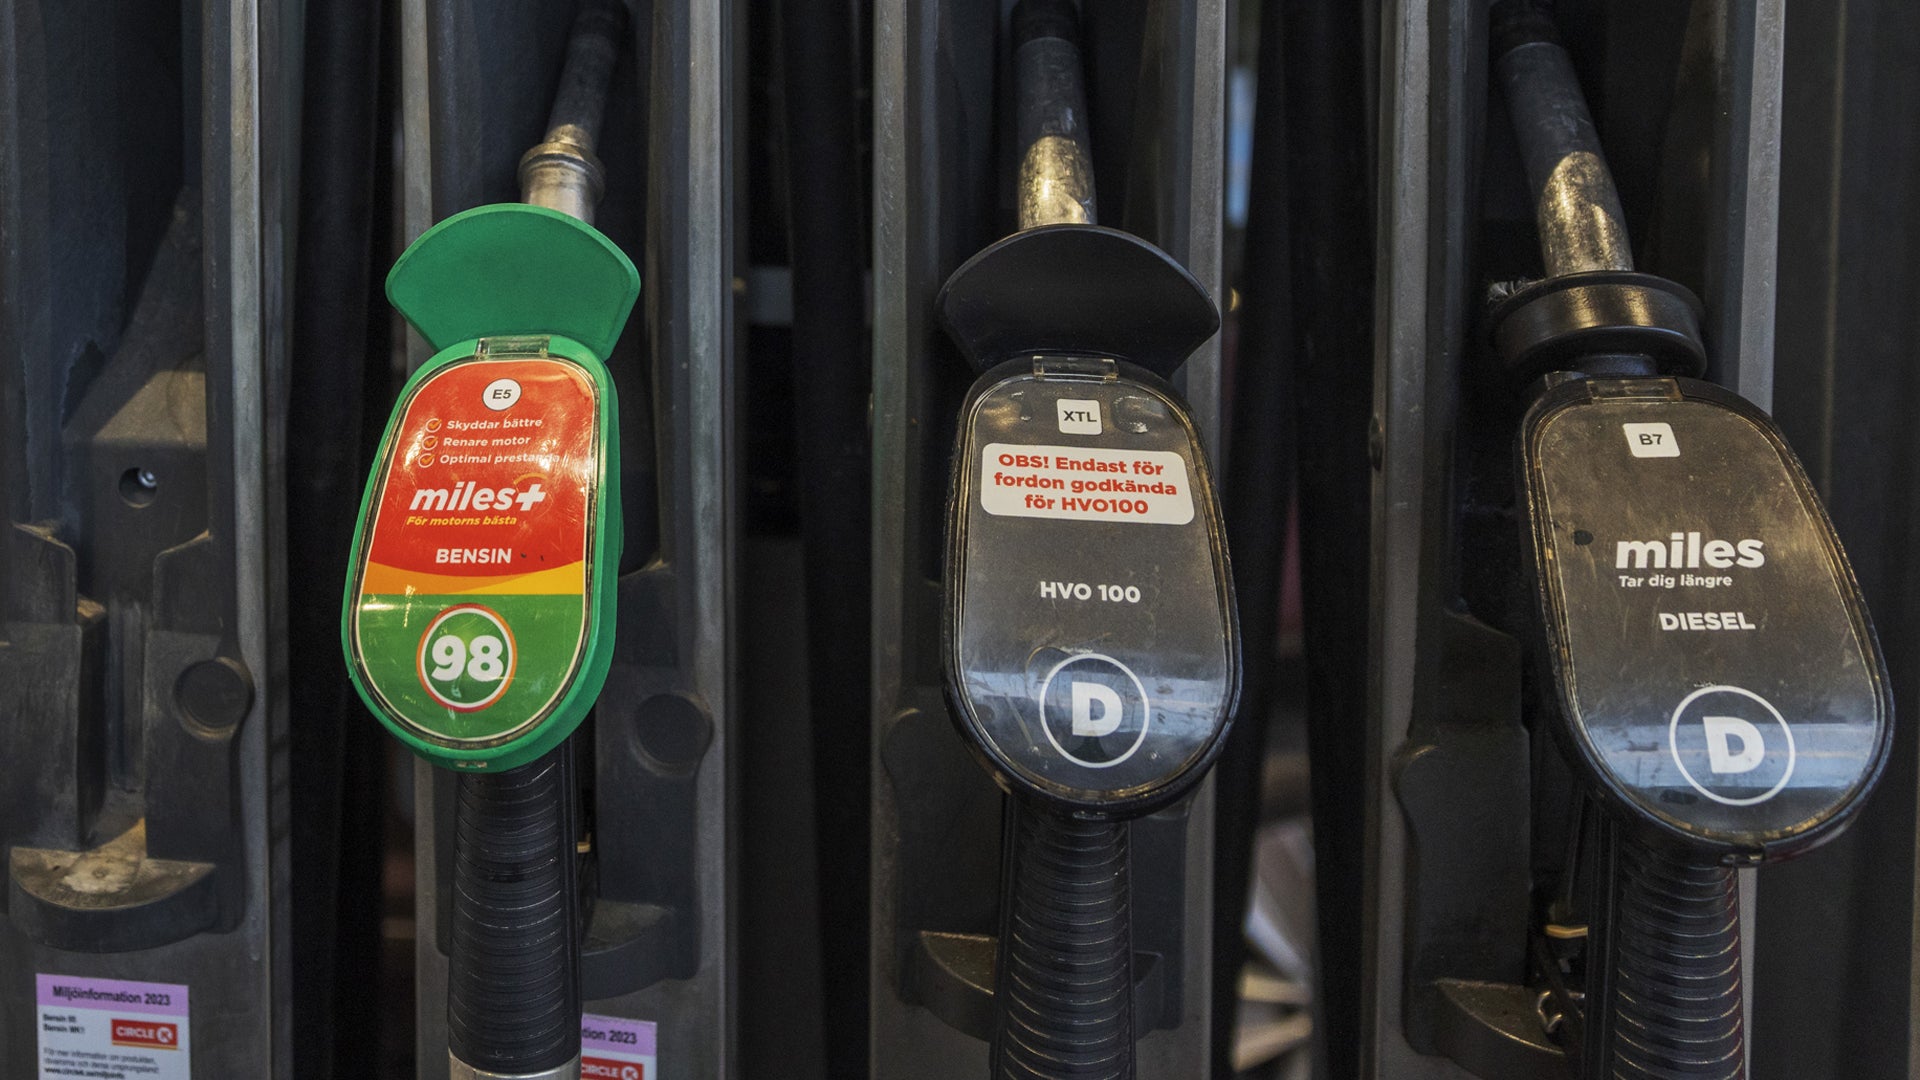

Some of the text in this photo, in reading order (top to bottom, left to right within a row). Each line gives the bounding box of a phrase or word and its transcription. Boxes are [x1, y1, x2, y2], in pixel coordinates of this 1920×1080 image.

[492, 389, 511, 400] E5
[446, 418, 543, 431] Skyddar bättre
[1063, 410, 1097, 423] XTL
[443, 436, 531, 447] Renare motor
[1639, 433, 1663, 446] B7
[439, 454, 491, 465] Optimal
[998, 453, 1164, 476] OBS! Endast för
[993, 472, 1177, 496] fordon godkända
[1024, 495, 1149, 515] för HVO100
[406, 515, 518, 526] För motorns bästa
[435, 548, 512, 564] BENSIN
[1615, 531, 1765, 570] miles
[1618, 574, 1733, 589] Tar dig längre
[1040, 581, 1142, 604] HVO 100
[1658, 612, 1756, 631] DIESEL
[431, 634, 504, 682] 98
[1072, 681, 1123, 737] D
[1702, 716, 1765, 774] D
[145, 995, 171, 1007] 2023
[116, 1026, 155, 1040] CIRCLE
[608, 1029, 638, 1045] 2023
